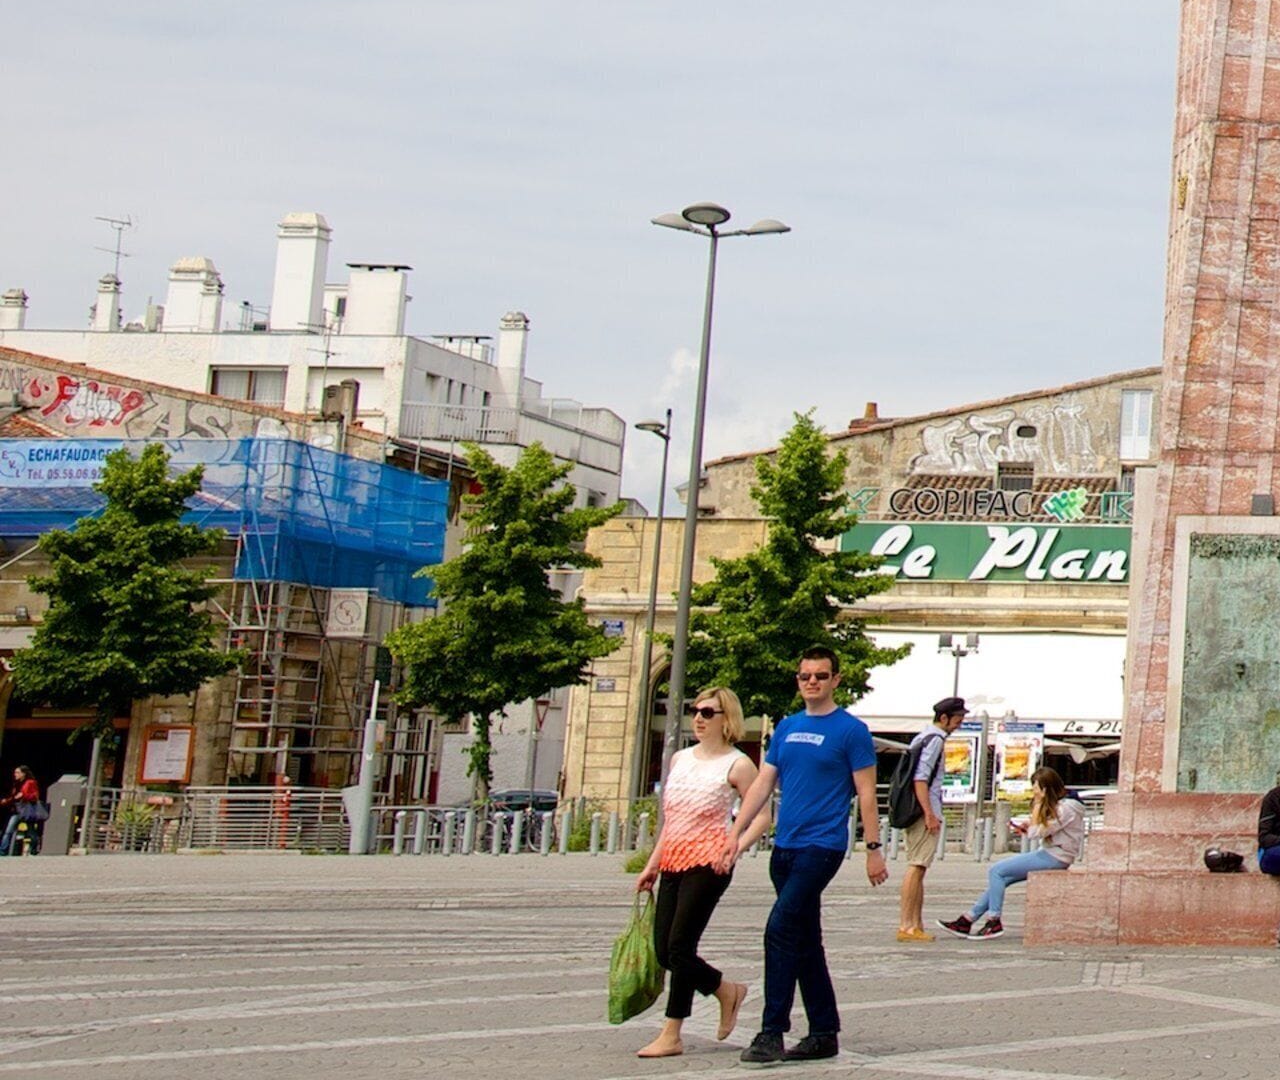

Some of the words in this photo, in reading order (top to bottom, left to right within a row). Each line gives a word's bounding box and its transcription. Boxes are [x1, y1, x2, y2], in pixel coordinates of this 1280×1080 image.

[889, 488, 1033, 518] COPIFAC
[856, 524, 937, 578] Le
[968, 525, 1129, 581] Plan
